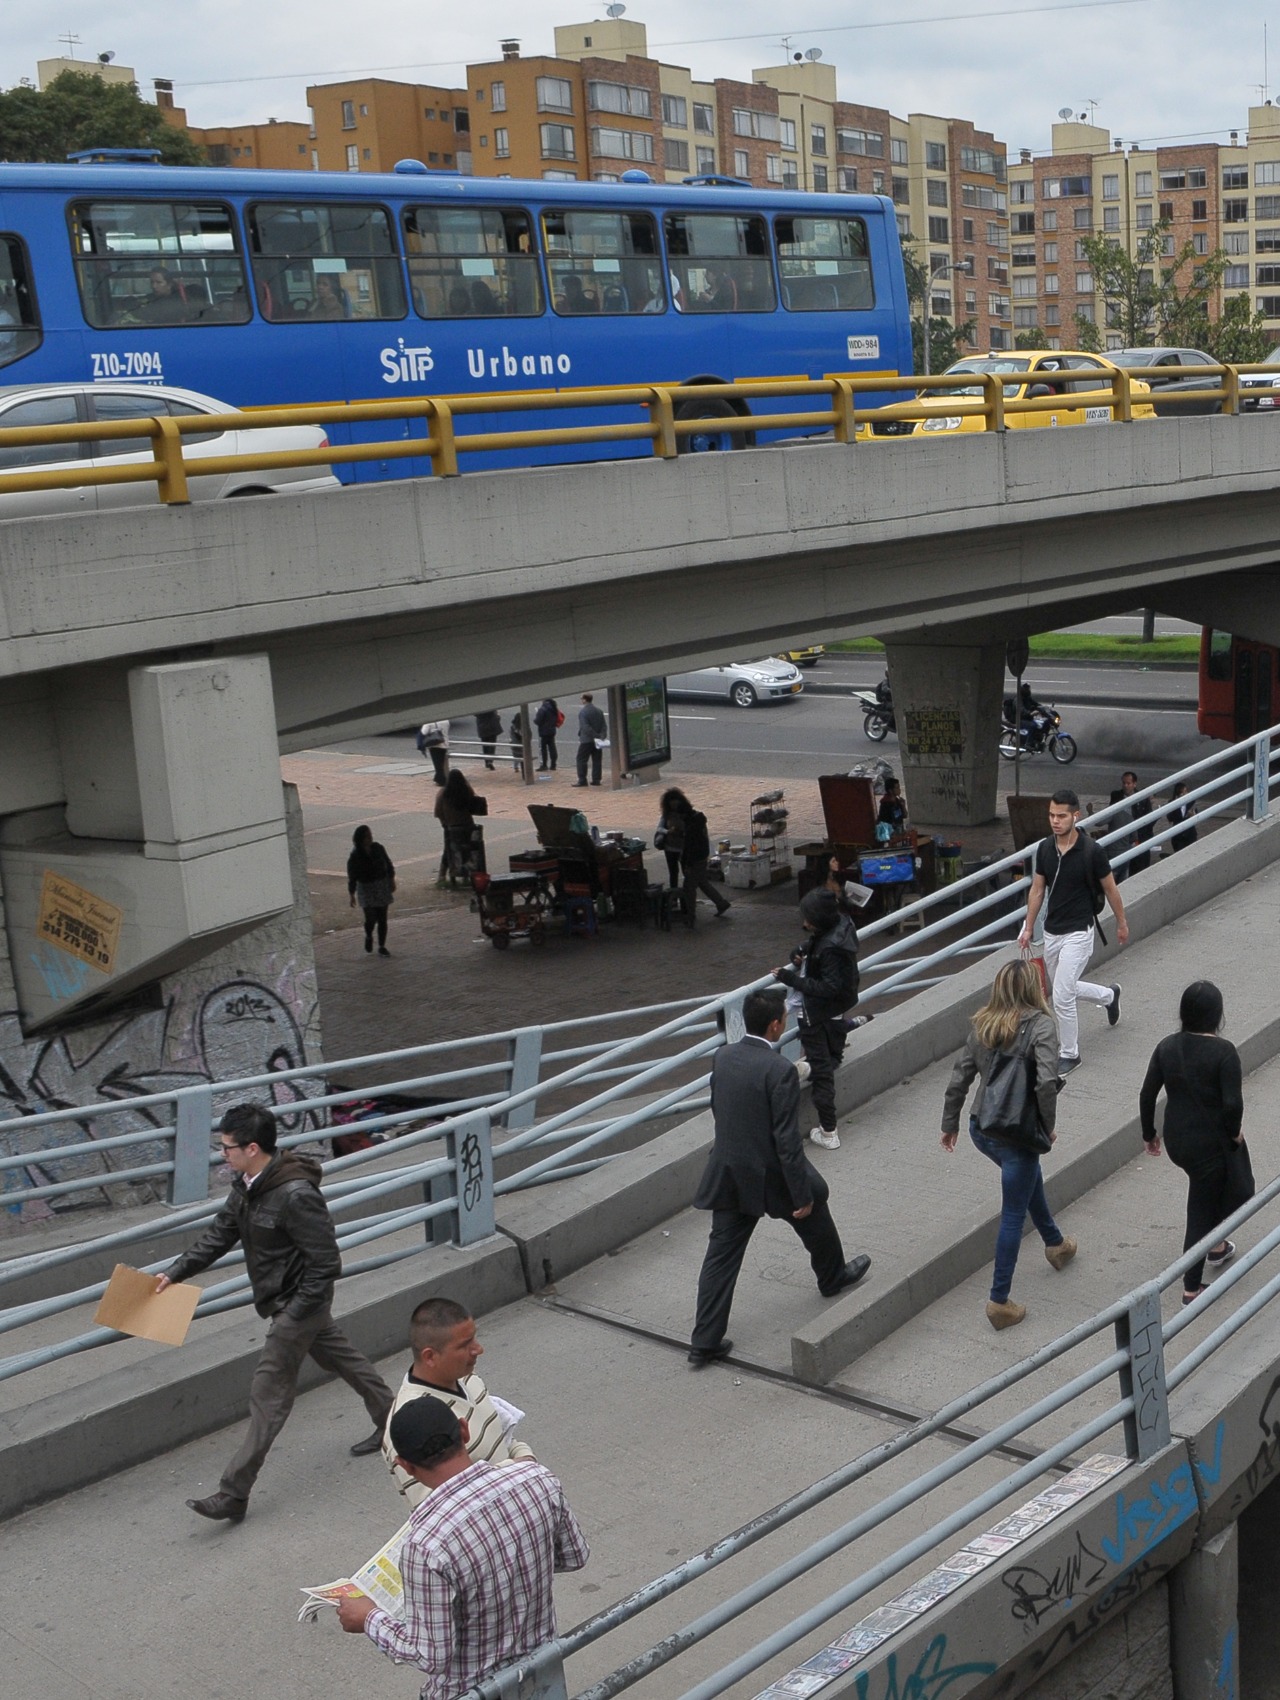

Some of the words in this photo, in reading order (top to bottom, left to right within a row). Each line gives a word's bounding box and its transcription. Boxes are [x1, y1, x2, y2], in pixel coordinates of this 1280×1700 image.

[91, 351, 162, 377] Z10-7094
[467, 346, 571, 378] Urbano
[921, 721, 955, 731] PLANOS
[43, 920, 62, 938] 314
[83, 942, 96, 957] 13
[97, 951, 110, 965] 19
